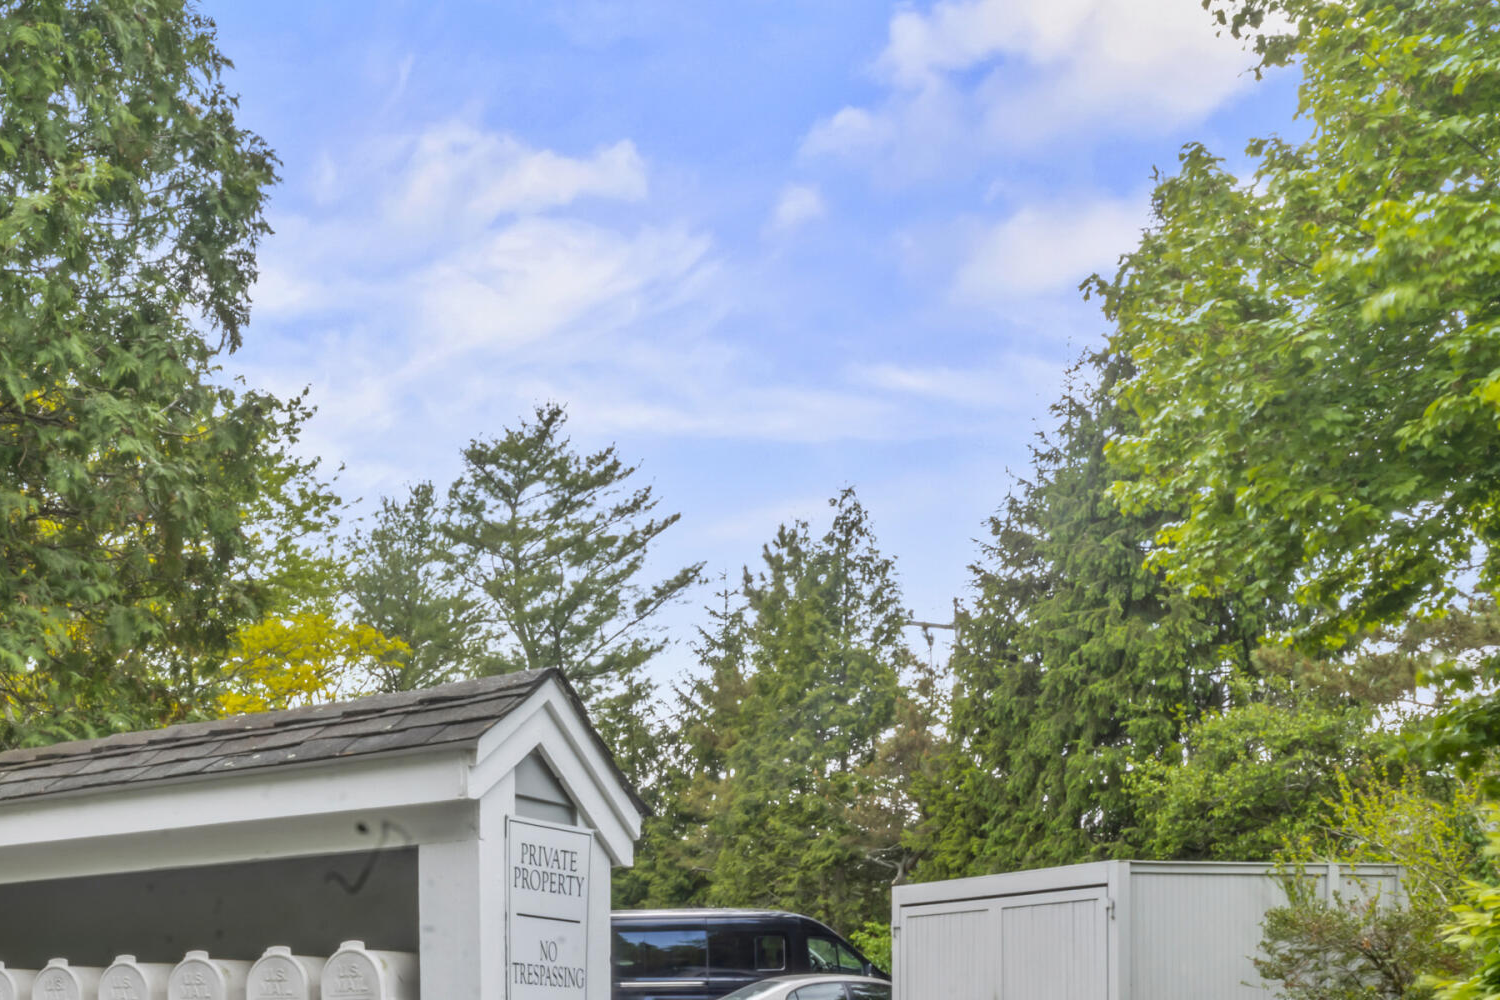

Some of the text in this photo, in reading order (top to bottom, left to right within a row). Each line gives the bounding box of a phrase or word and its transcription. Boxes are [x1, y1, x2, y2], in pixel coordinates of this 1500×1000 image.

[521, 842, 578, 872] PRIVATE
[514, 866, 585, 897] PROPERTY
[540, 940, 558, 962] NO
[512, 962, 585, 989] TRESPASSING
